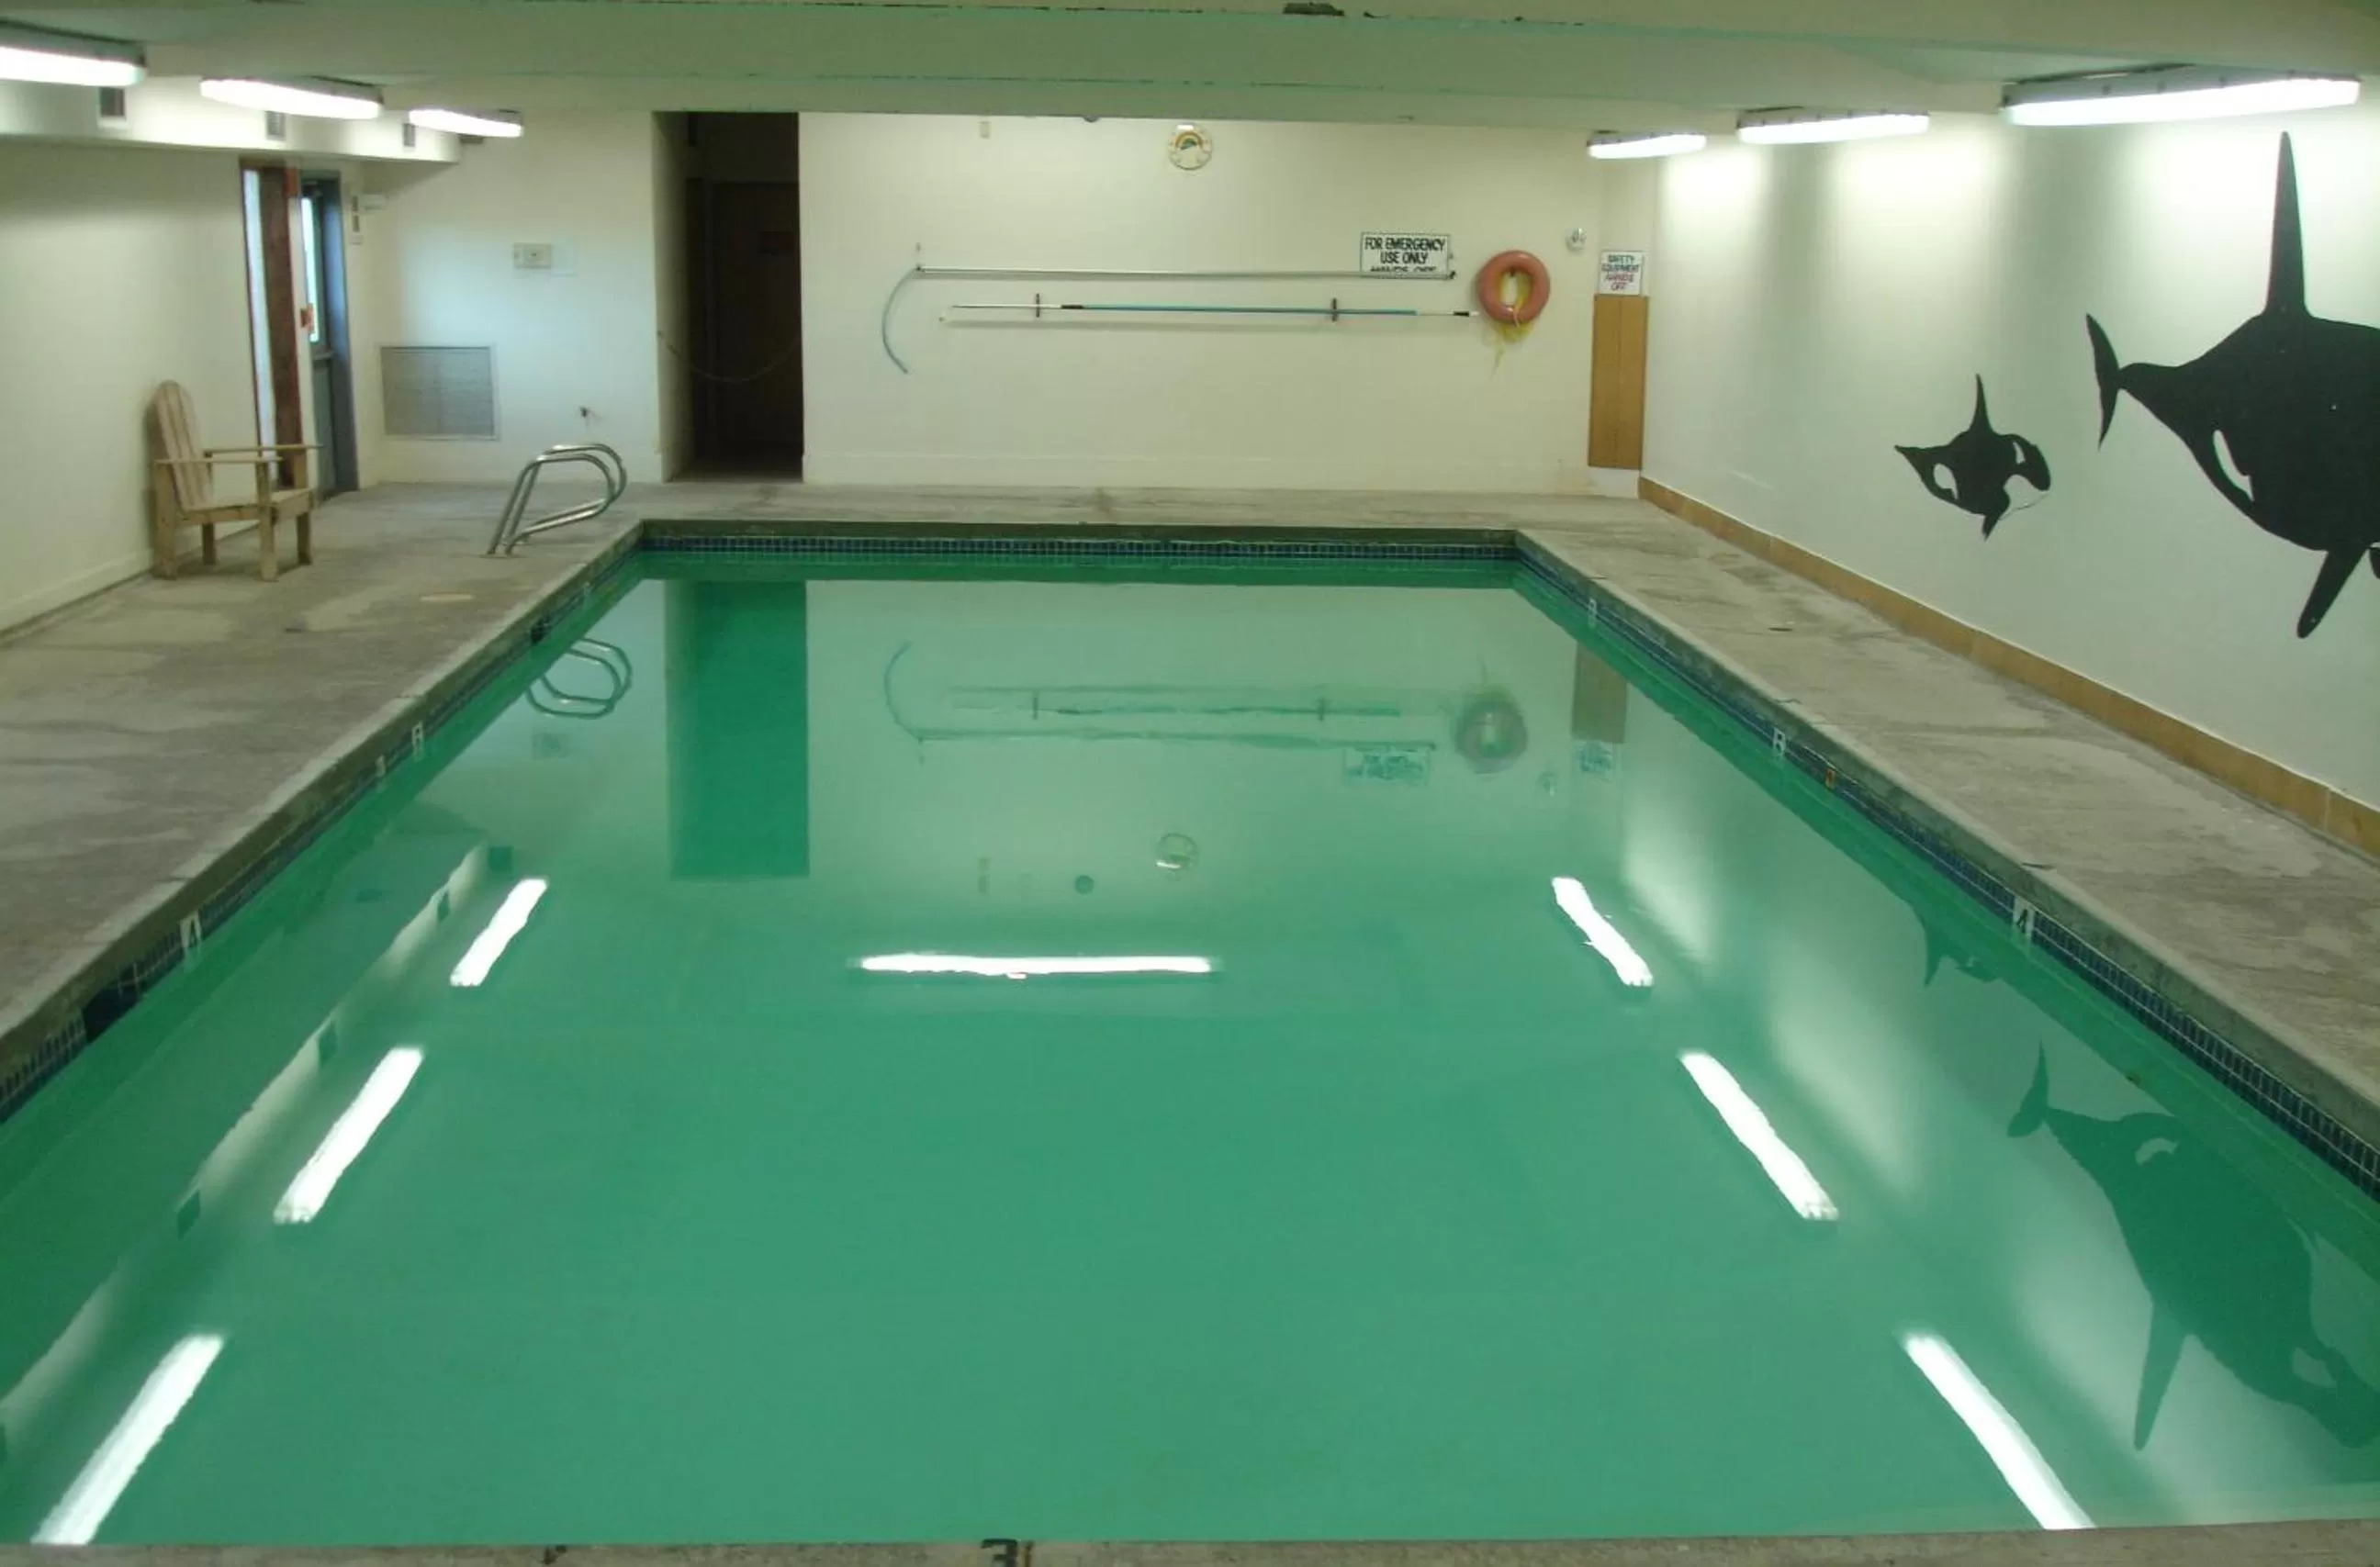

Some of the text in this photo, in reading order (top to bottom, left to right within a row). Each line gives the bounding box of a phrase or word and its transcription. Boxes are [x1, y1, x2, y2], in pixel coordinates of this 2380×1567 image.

[1364, 237, 1445, 252] FOR EMERGENCY
[1380, 252, 1429, 264] USE ONLY
